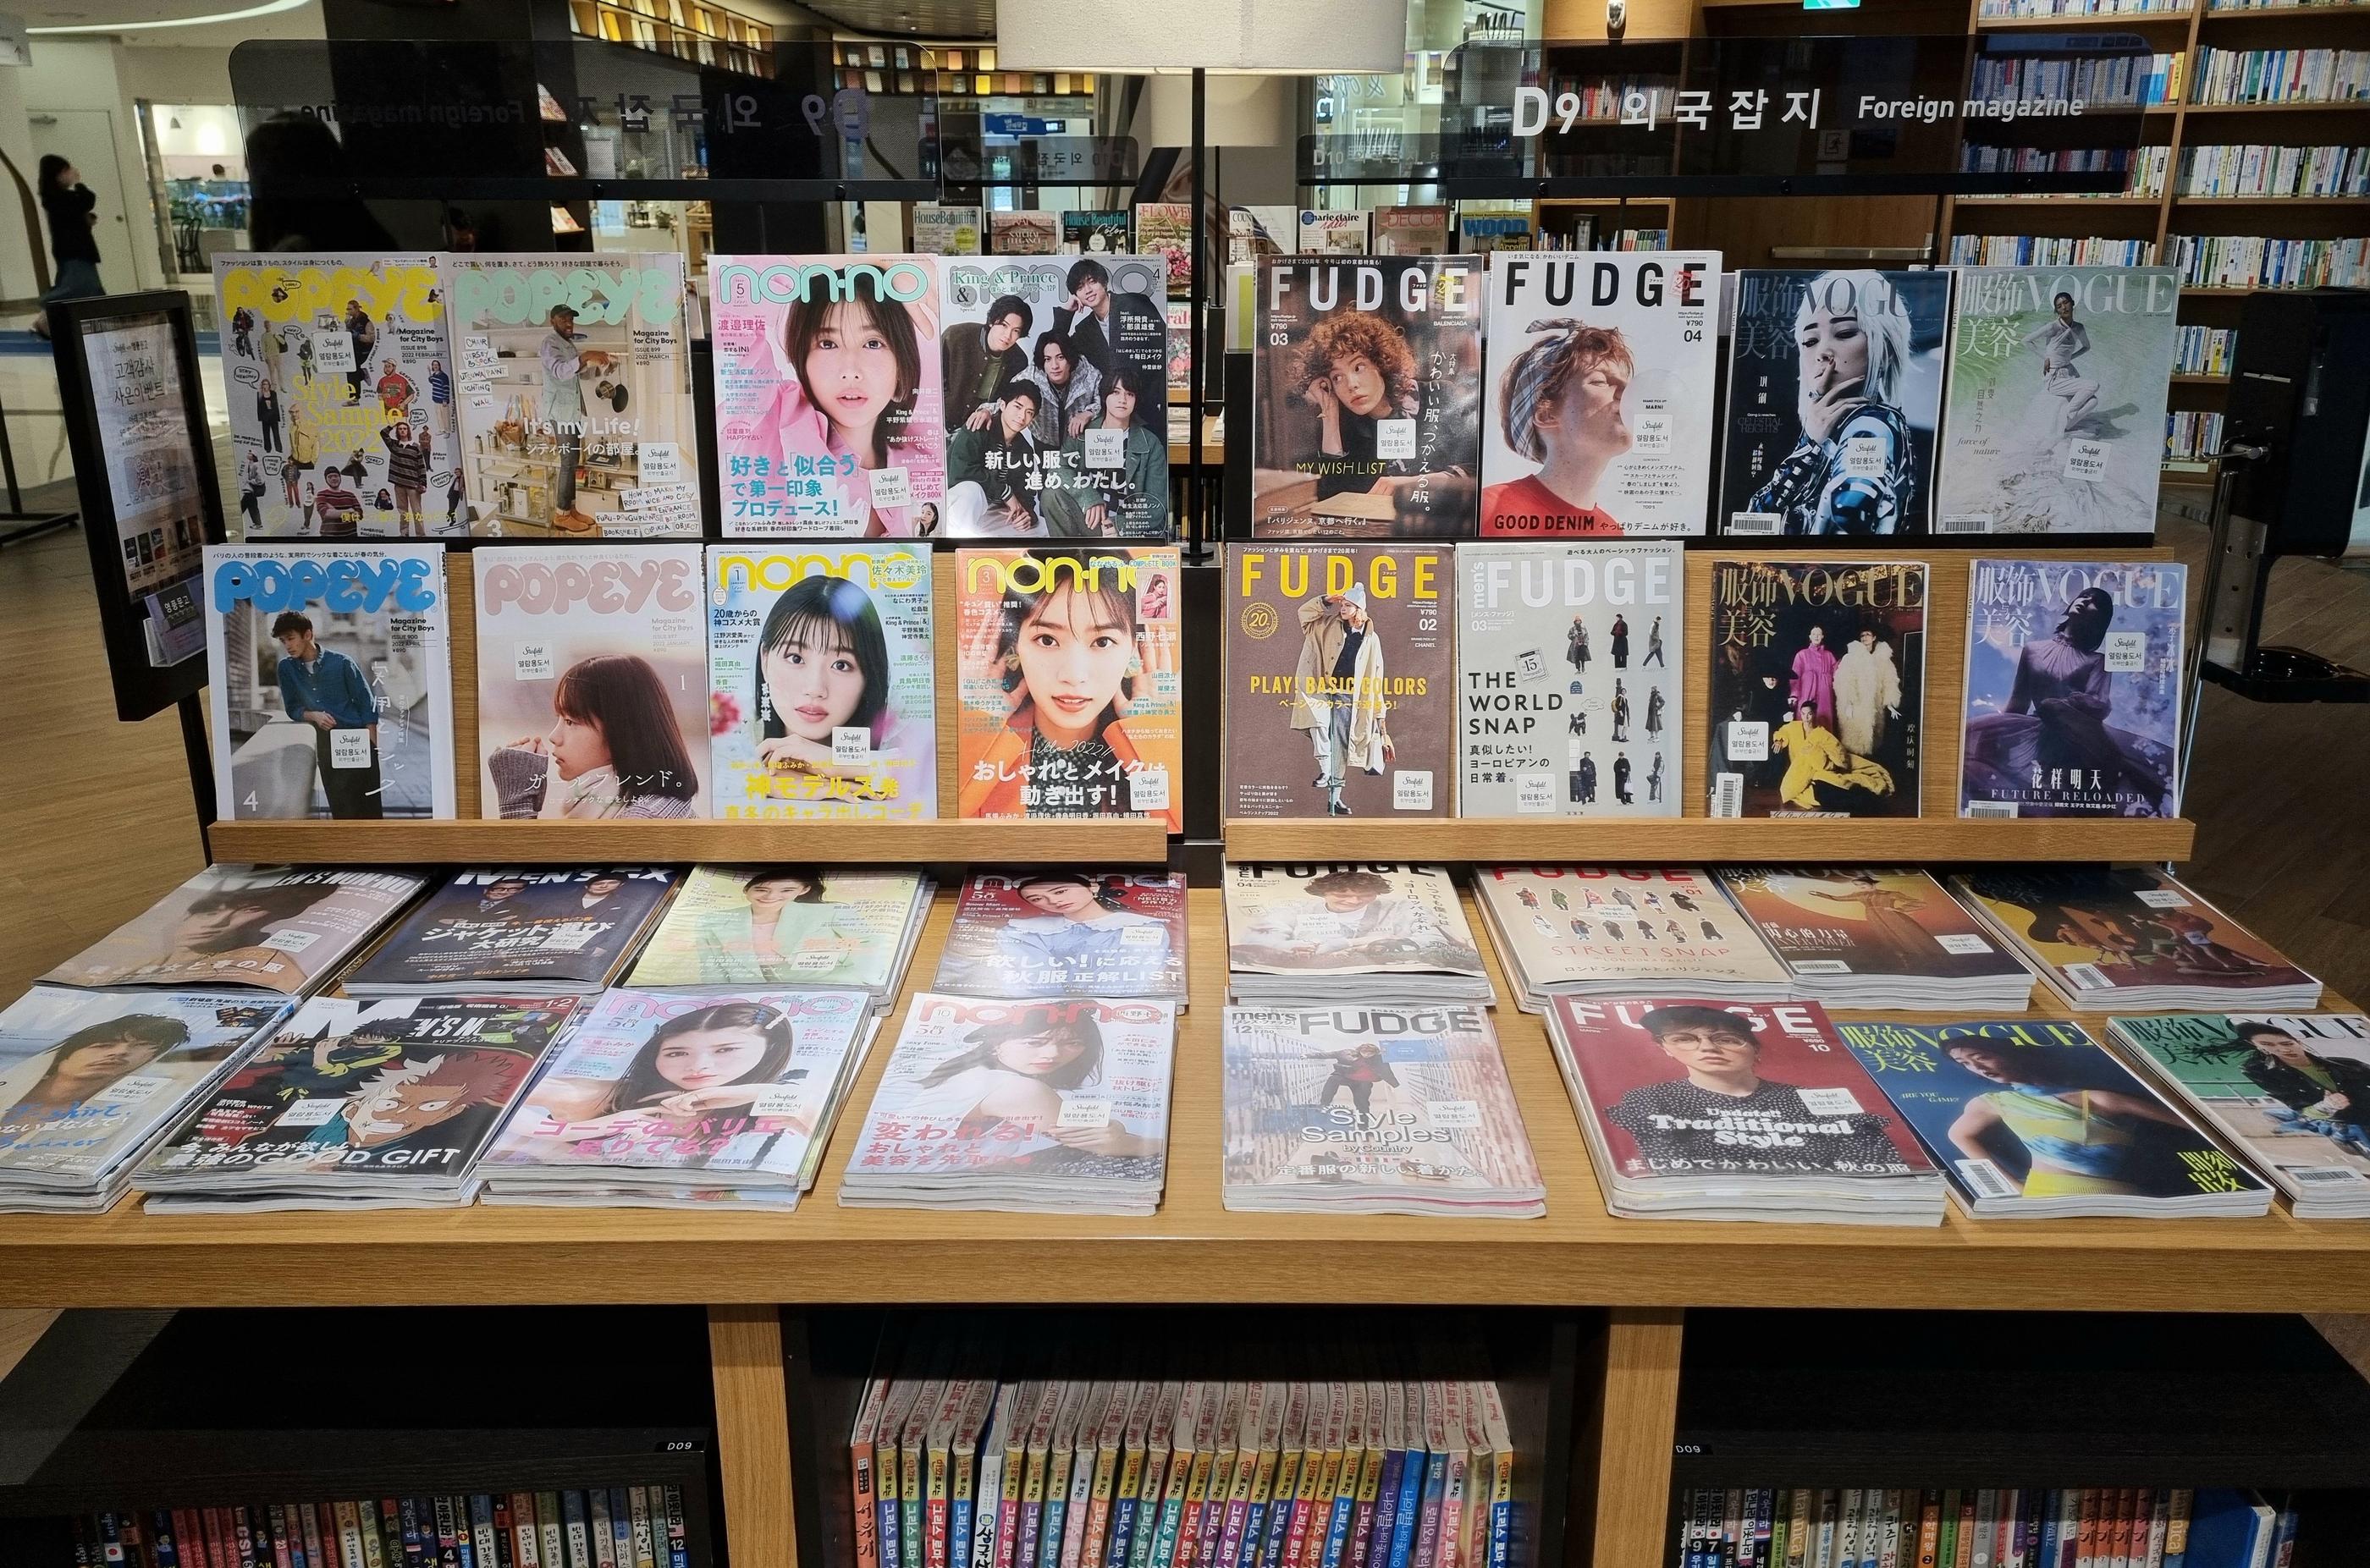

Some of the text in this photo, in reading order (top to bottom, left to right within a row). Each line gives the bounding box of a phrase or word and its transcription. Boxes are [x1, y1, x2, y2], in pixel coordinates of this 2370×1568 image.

[1513, 87, 2084, 136] D9 외국잡지 Foreign magazine
[954, 272, 989, 286] King
[1011, 272, 1055, 283] Prince
[1506, 262, 1706, 307] FUDGE
[1270, 267, 1469, 311] FUDGE
[1270, 333, 1288, 345] 03
[1684, 330, 1702, 342] 04
[557, 421, 588, 438] my
[1318, 462, 1353, 475] WISH
[1357, 462, 1386, 475] LIST
[1495, 515, 1540, 531] GOOD
[1545, 515, 1595, 531] DENIM
[1242, 554, 1438, 599] FUDGE
[1487, 557, 1670, 608] FUDGE
[214, 559, 436, 613] POPEYE
[484, 559, 696, 616] POPEYE
[1778, 568, 1923, 608] VOGUE
[1419, 619, 1436, 630] 02
[1250, 677, 1427, 695] PLAY! BASIC COLORS
[1469, 672, 1516, 689] THE
[1469, 694, 1563, 712] WORLD
[1469, 718, 1535, 735] SNAP
[1469, 745, 1532, 756] 真似したい!
[243, 790, 258, 812] 4
[1991, 789, 2146, 802] FUTURE RELOADED
[1551, 945, 1731, 957] STREET SNAP
[1232, 1011, 1483, 1035] men's FUDGE
[1232, 1026, 1253, 1034] 12
[1808, 1043, 1831, 1052] 10
[1329, 1108, 1416, 1125] Style
[1649, 1114, 1855, 1135] Traditional
[1300, 1126, 1451, 1146] Samples
[1714, 1131, 1806, 1148] Style
[389, 1148, 460, 1164] GIFT
[1354, 1144, 1413, 1153] Country
